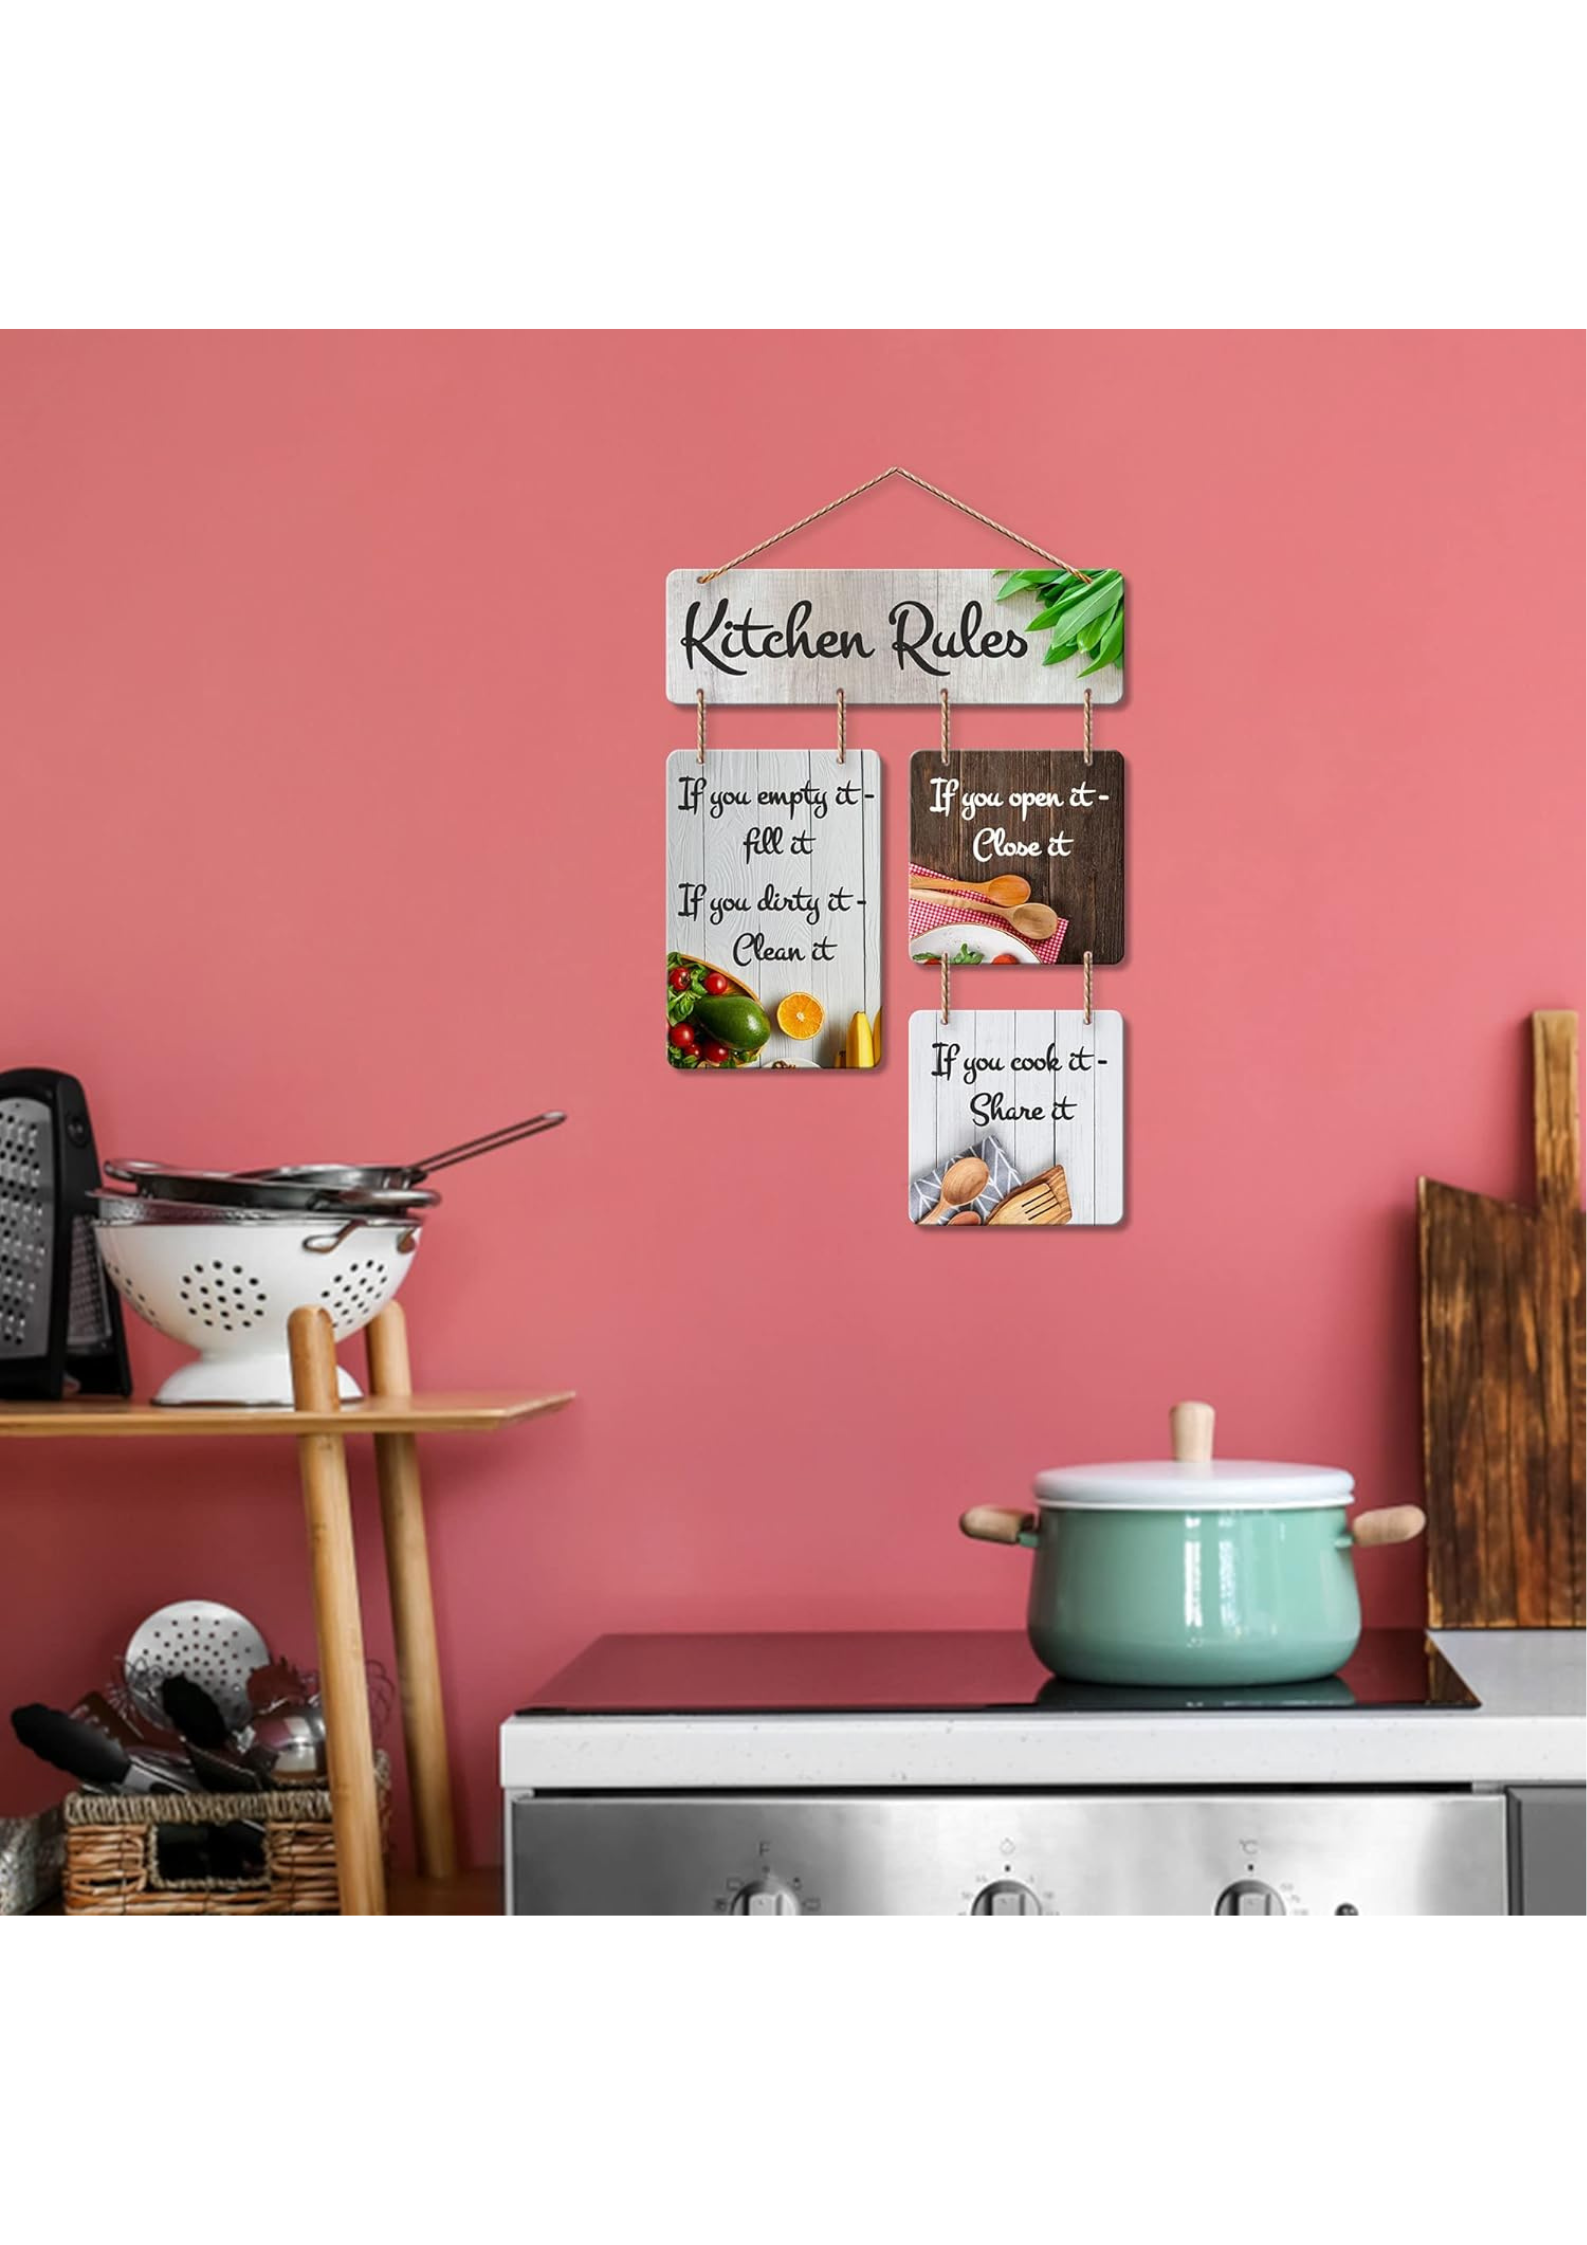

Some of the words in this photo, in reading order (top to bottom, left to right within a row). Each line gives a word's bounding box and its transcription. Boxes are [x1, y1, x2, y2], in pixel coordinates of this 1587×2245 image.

[680, 597, 876, 676] Kitchen
[888, 600, 1029, 677] Rules
[677, 775, 707, 815] If
[709, 791, 752, 819] you
[757, 778, 828, 820] empty
[835, 780, 862, 806] it
[929, 776, 960, 817] If
[961, 792, 1004, 821] you
[1008, 792, 1065, 822] open
[1069, 781, 1098, 808] it
[742, 826, 784, 865] fill
[790, 829, 816, 855] it
[972, 827, 1043, 863] Close
[1047, 830, 1074, 857] it
[677, 882, 707, 922] If
[709, 897, 752, 926] you
[757, 883, 821, 926] dirty
[827, 886, 854, 912] it
[732, 932, 806, 967] Clean
[811, 936, 838, 961] it
[931, 1042, 961, 1081] If
[963, 1057, 1005, 1085] you
[1010, 1042, 1063, 1073] cook
[1068, 1046, 1095, 1072] it
[969, 1092, 1046, 1127] Share
[1051, 1095, 1077, 1121] it
